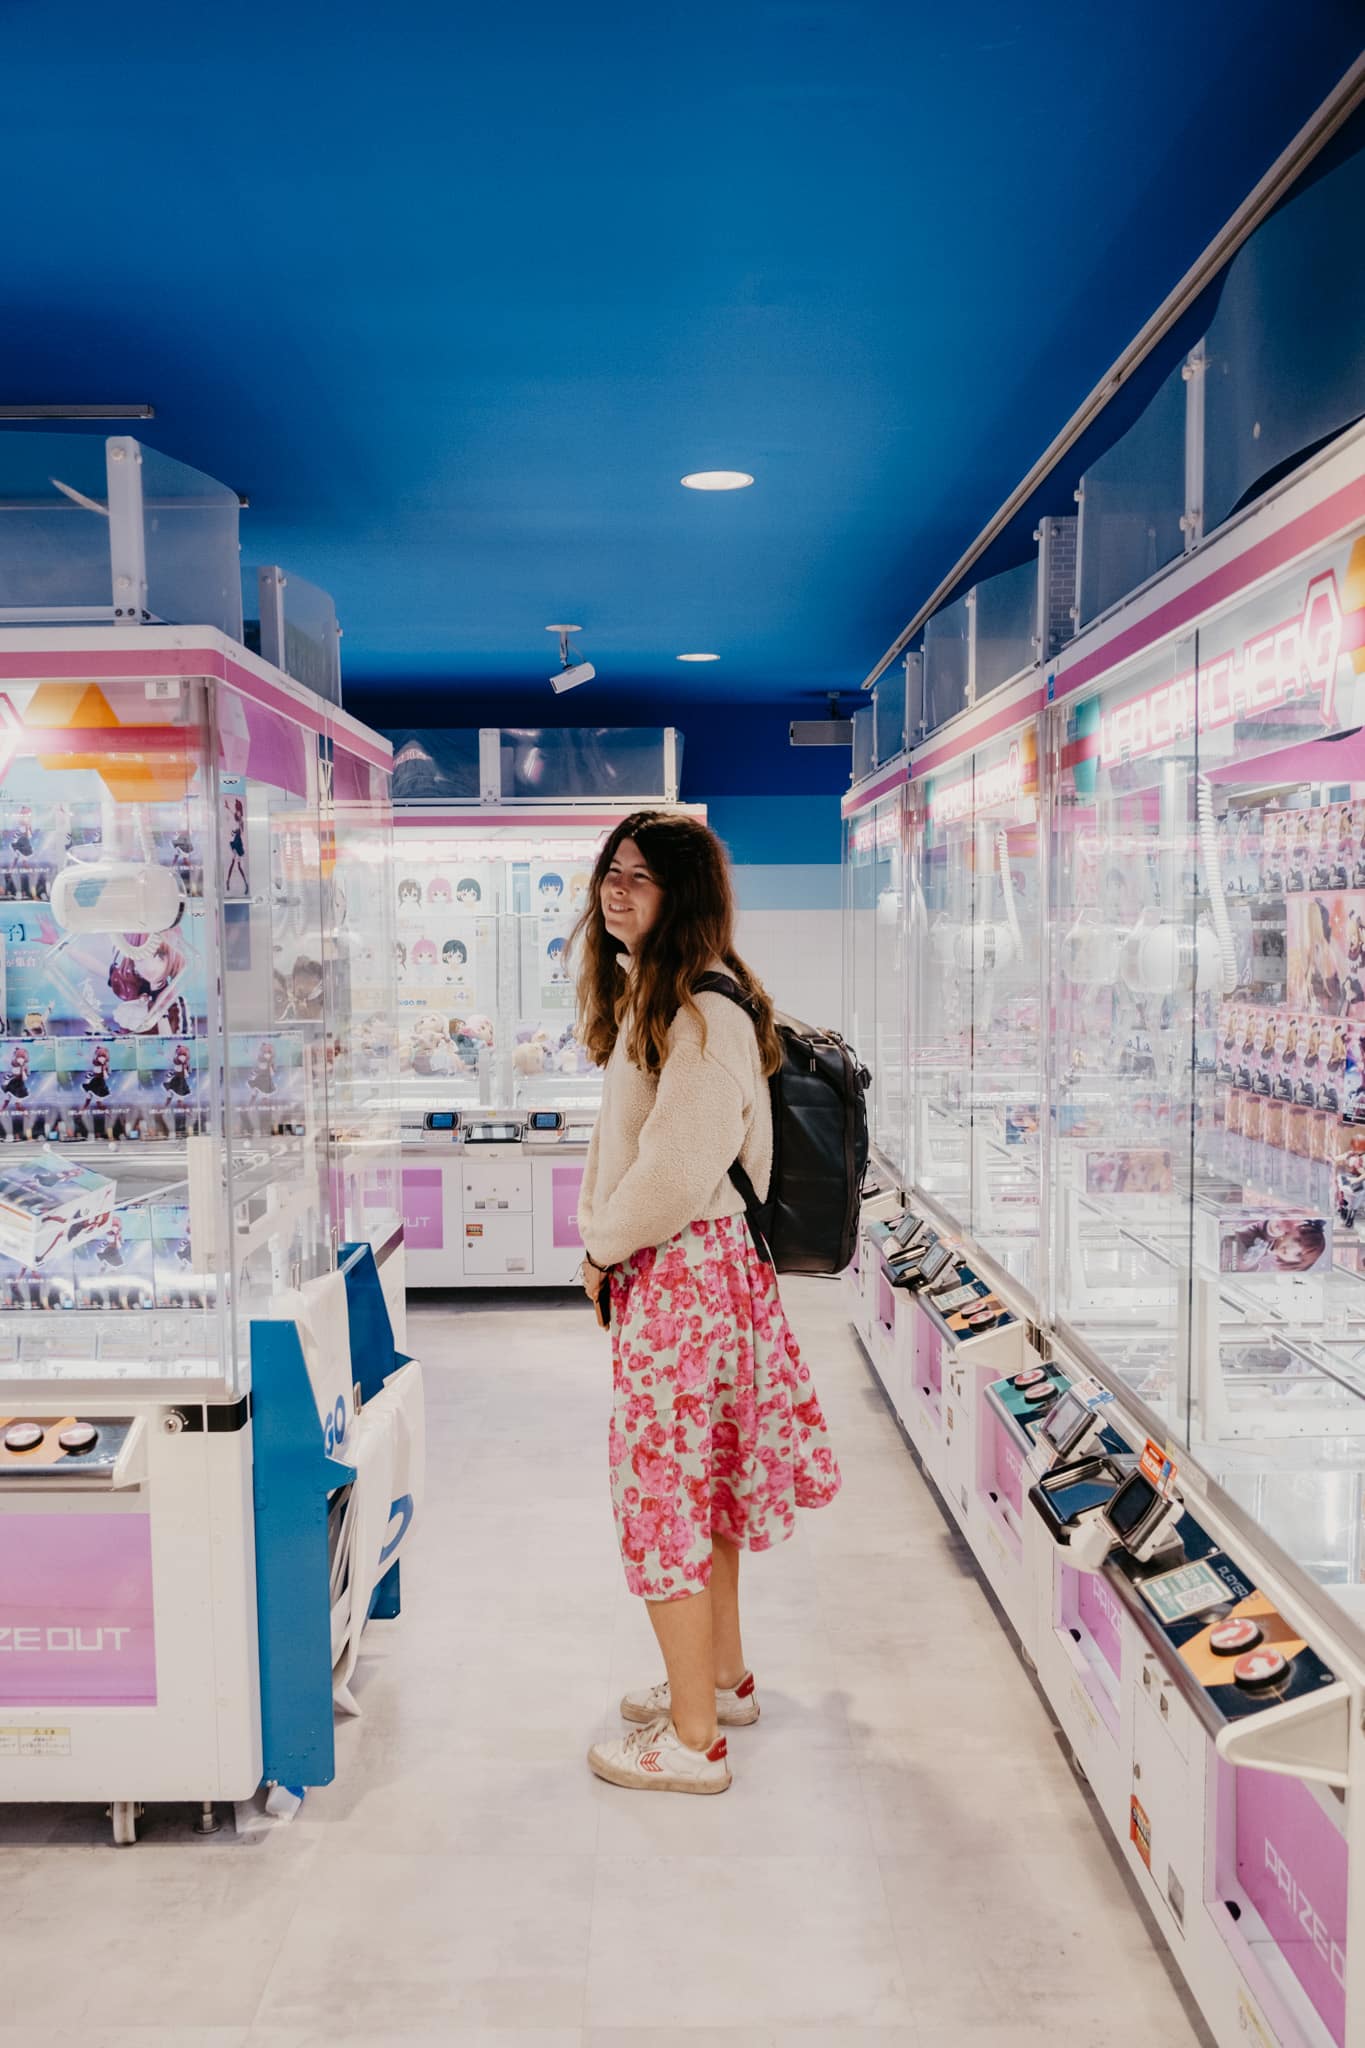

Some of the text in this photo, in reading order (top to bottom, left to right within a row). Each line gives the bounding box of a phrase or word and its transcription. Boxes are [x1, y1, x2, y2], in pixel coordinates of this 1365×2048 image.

[1217, 1565, 1249, 1597] PLAYER
[1092, 1575, 1121, 1633] PRIZ
[46, 1627, 131, 1651] OUT
[1264, 1836, 1329, 1962] PRIZE
